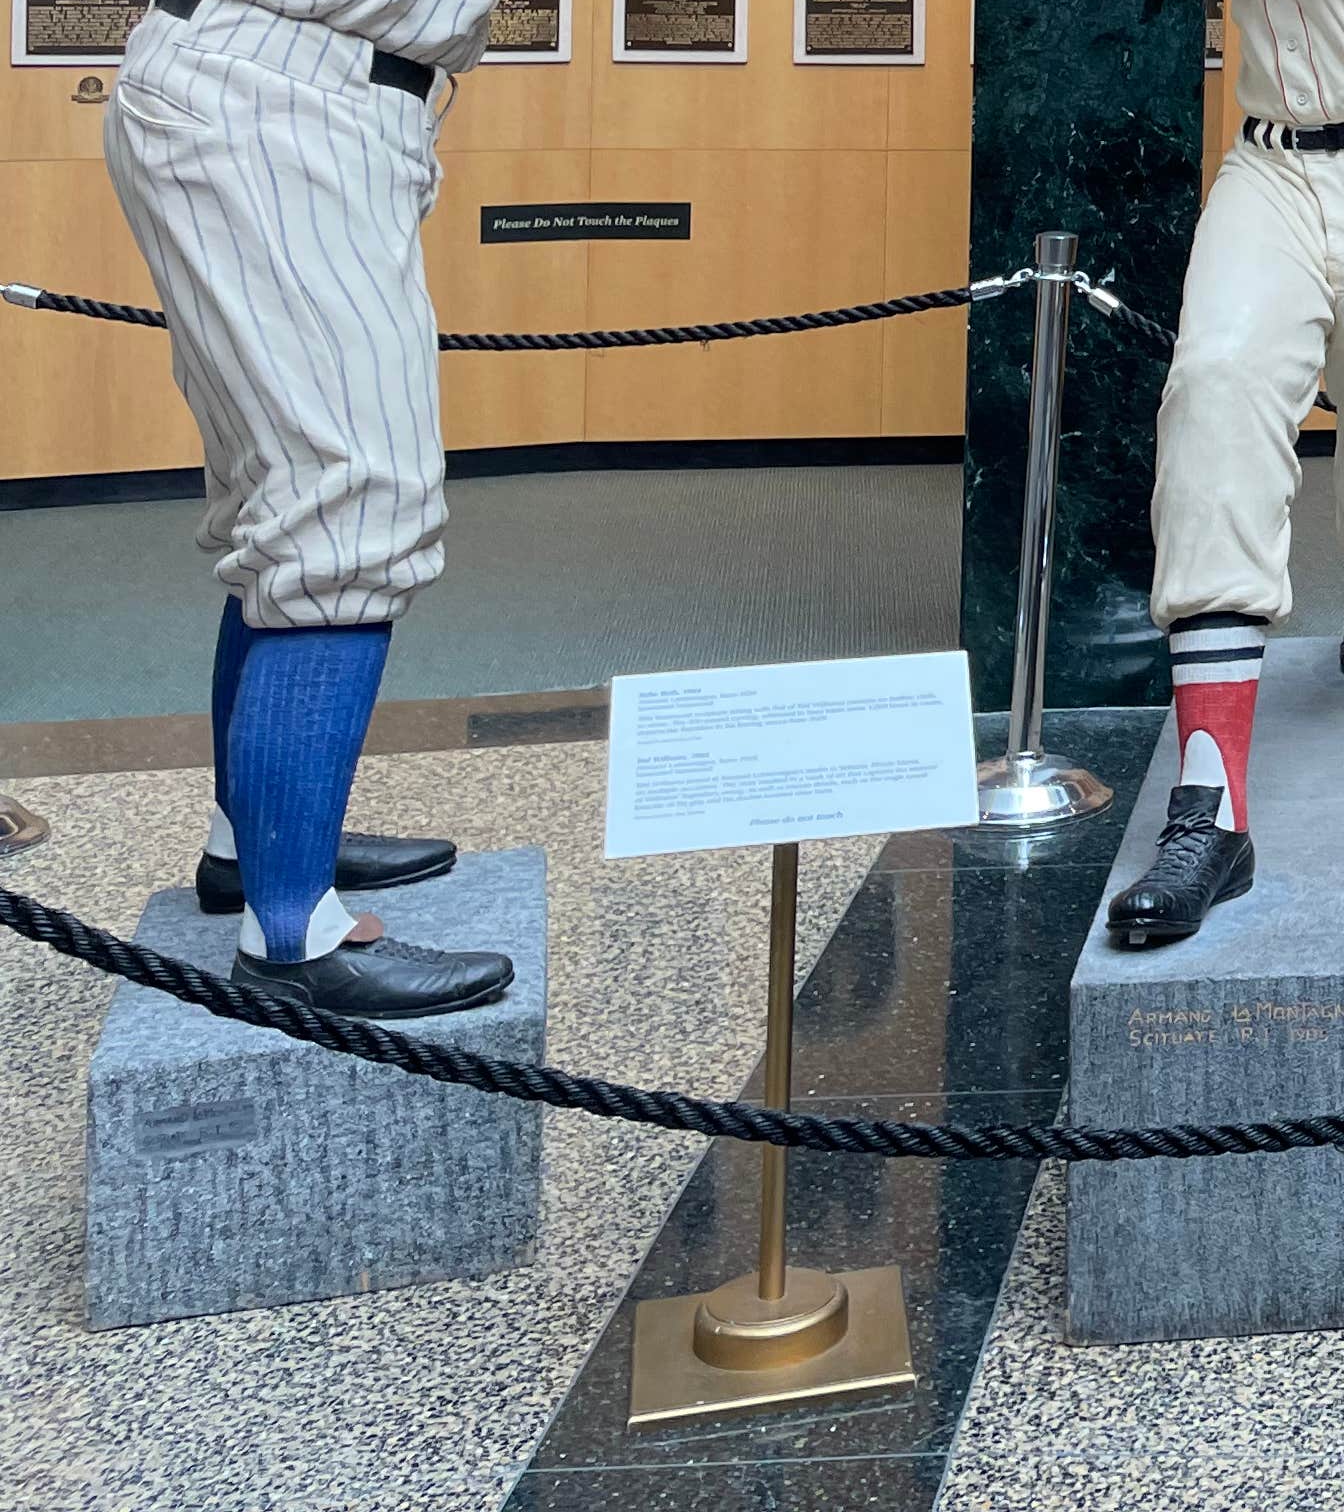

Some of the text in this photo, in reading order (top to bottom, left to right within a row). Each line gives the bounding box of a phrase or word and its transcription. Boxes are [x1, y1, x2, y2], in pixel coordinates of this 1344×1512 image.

[493, 215, 679, 230] Please Do Not Touch the Plaques
